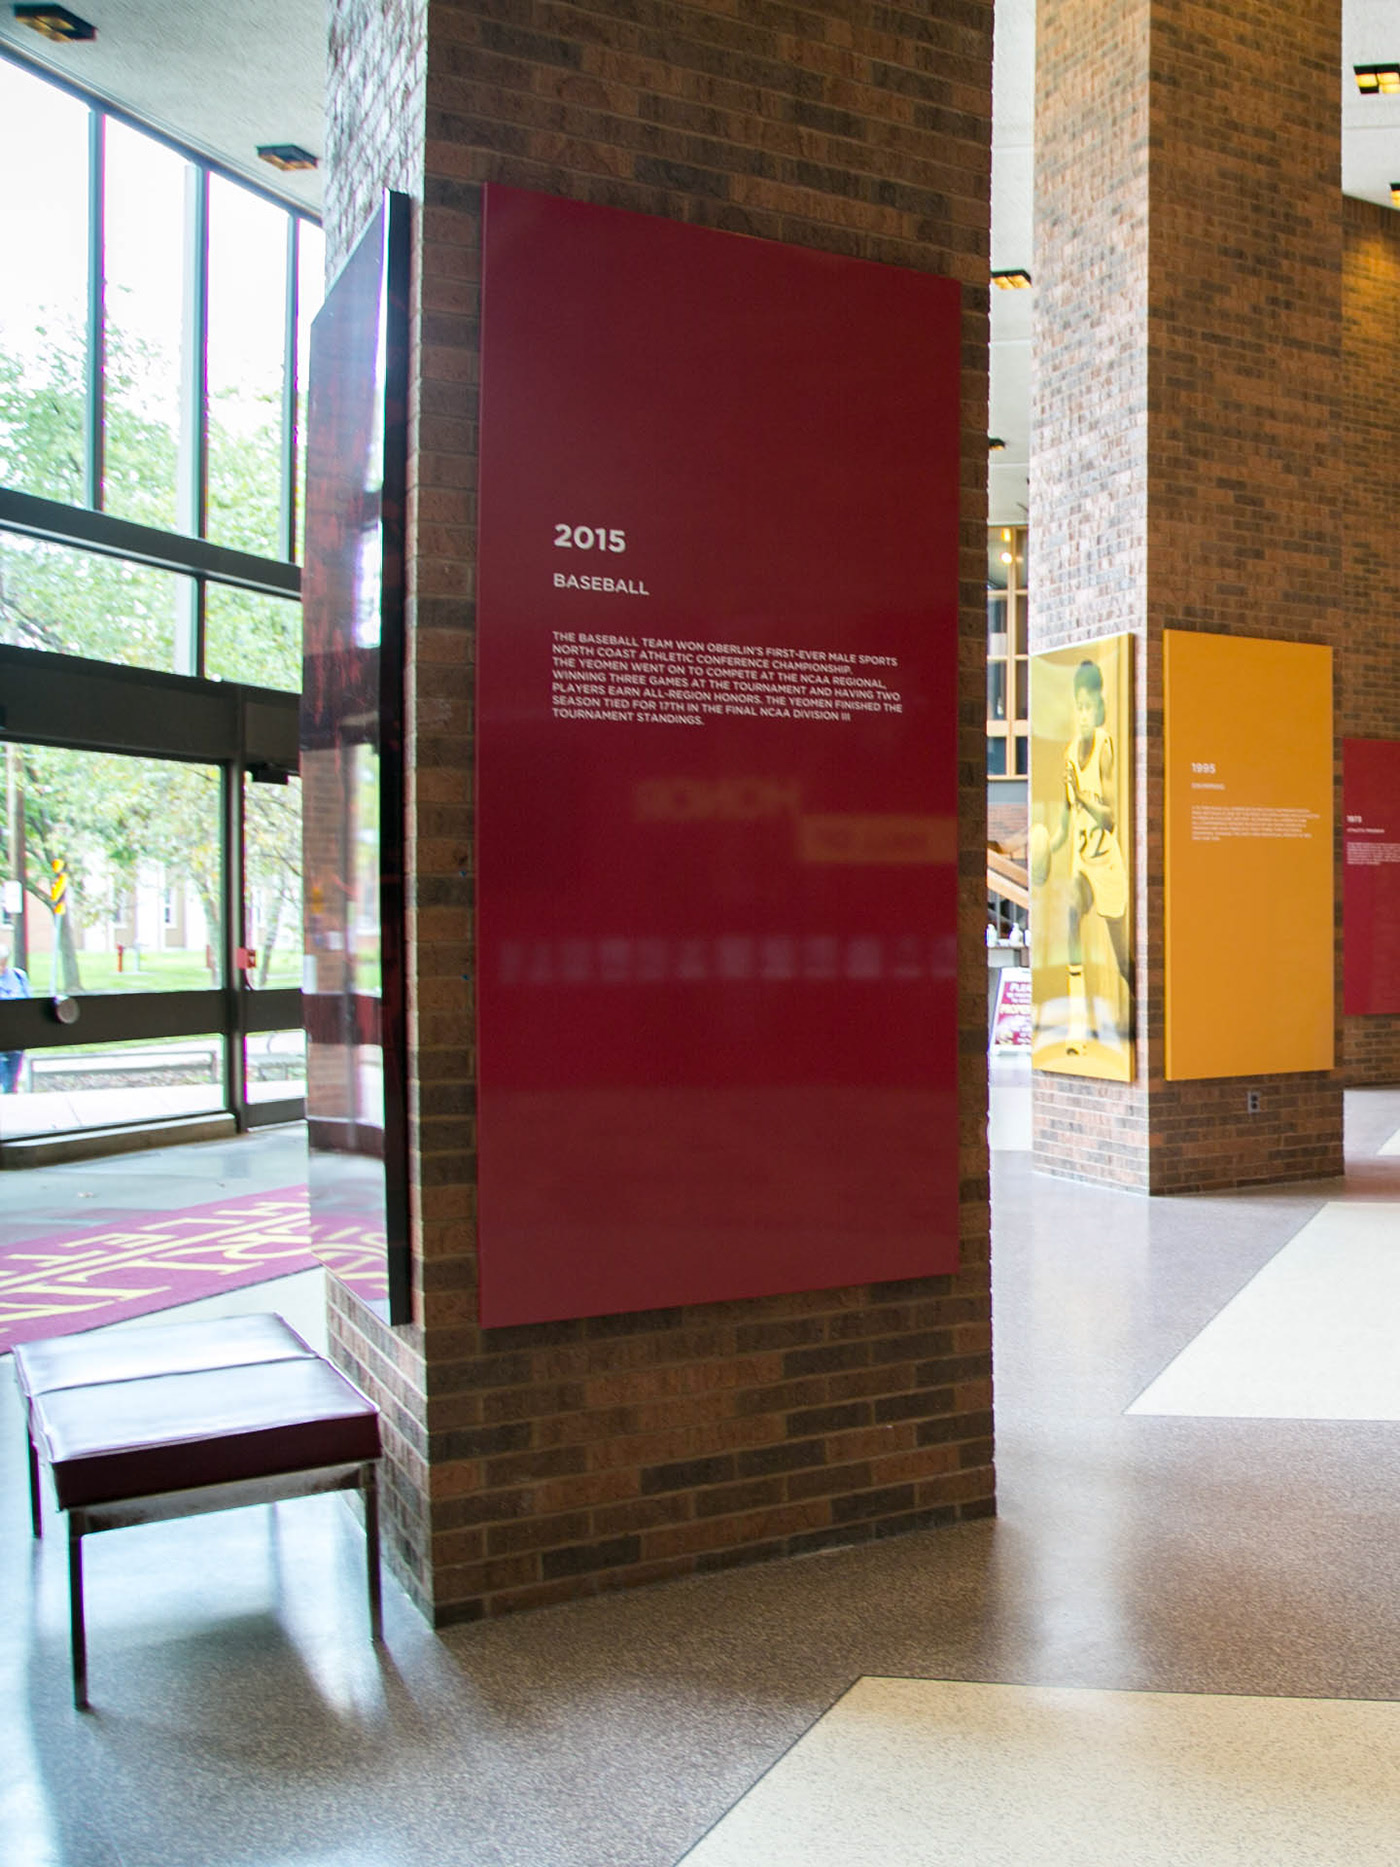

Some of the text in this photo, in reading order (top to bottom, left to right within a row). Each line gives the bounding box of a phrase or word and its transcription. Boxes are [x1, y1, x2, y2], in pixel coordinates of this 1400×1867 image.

[553, 523, 627, 553] 2015
[552, 572, 650, 596] BASEBALL
[552, 631, 576, 643] THE
[578, 633, 639, 647] BASEBALL
[642, 638, 673, 649] TEAM
[676, 640, 704, 651] WON
[828, 652, 856, 664] MALE
[859, 655, 898, 667] SPORTS
[552, 644, 594, 656] NORTH
[596, 647, 637, 659] COAST
[639, 650, 694, 663] ATHLETIC
[696, 654, 770, 669] CONFERENCE
[552, 656, 576, 668] THE
[578, 658, 628, 671] YEOMEN
[630, 662, 665, 674] WENT
[668, 664, 685, 675] ON
[688, 666, 703, 676] TO
[706, 668, 758, 680] COMPETE
[760, 671, 775, 680] AT
[777, 671, 798, 682] THE
[800, 674, 831, 685] NCAA
[552, 670, 900, 701] WINNING THREE GAMES AT THE TOURNAMENT AND HAVING TWO
[552, 682, 606, 695] PLAYERS
[608, 685, 640, 696] EARN
[765, 695, 786, 706] THE
[788, 697, 833, 709] YEOMEN
[834, 700, 881, 712] FINISHED
[883, 702, 903, 713] THE
[552, 695, 852, 722] SEASON TIED FOR 17TH IN THE FINAL NCAA DIVISION III
[552, 708, 634, 721] TOURNAMENT
